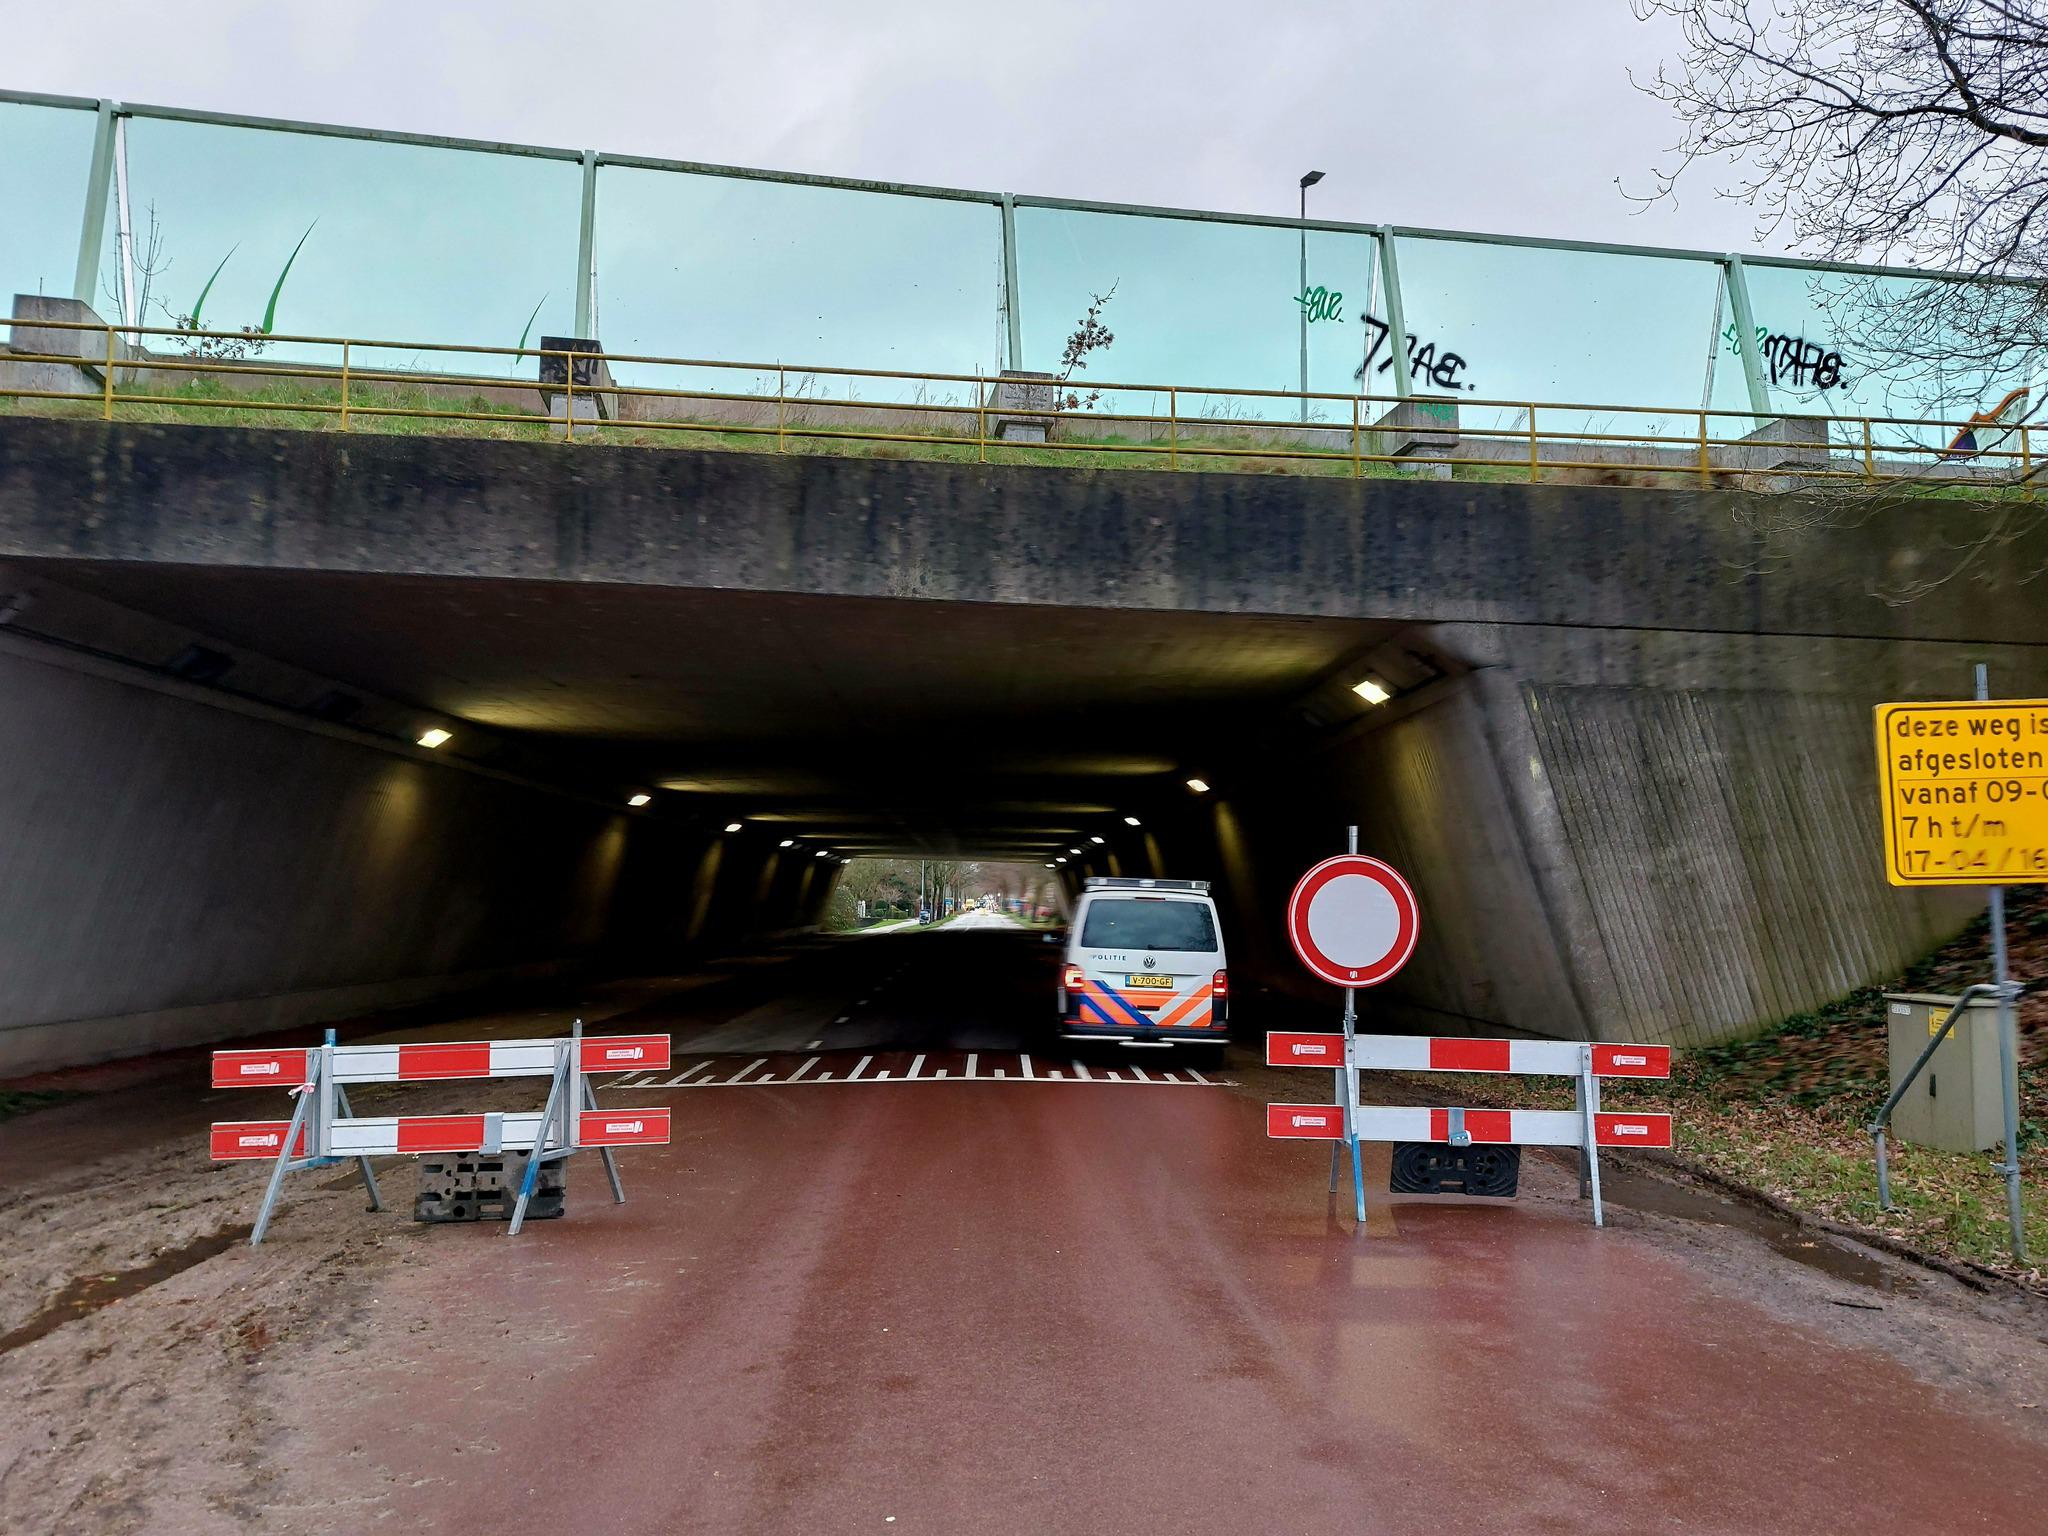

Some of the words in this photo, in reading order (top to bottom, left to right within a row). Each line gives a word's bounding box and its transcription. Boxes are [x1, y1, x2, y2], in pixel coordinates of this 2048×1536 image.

[1897, 715, 1959, 738] deze
[1968, 717, 2021, 742] weg
[2030, 712, 2048, 735] is
[1899, 747, 2043, 777] afgesloten
[1901, 780, 1978, 805] vanaf
[1950, 812, 2008, 838] t/m
